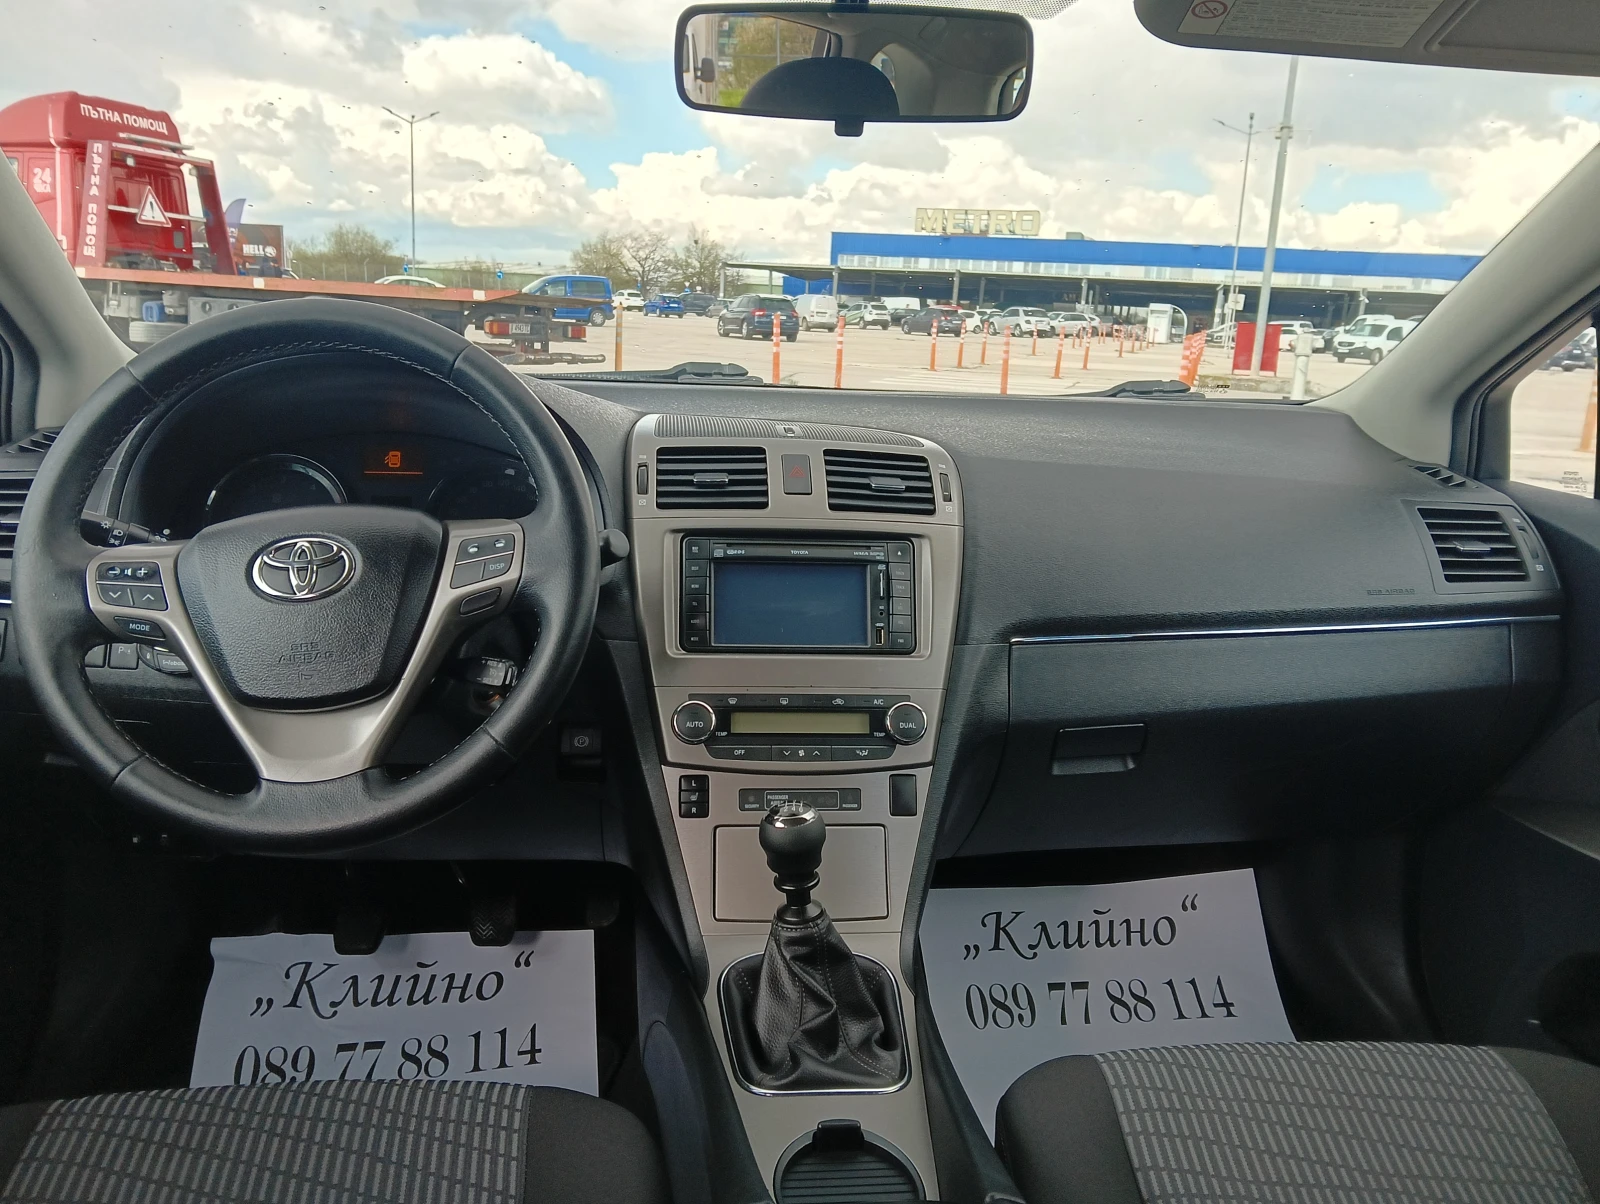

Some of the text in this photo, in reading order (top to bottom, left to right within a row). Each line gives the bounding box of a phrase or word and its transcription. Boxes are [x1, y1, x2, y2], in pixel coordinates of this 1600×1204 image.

[80, 103, 168, 136] ПЪТНА ПОМОЩ
[33, 167, 52, 184] 24
[83, 142, 103, 258] ПЪТНА ПОМОЩ
[915, 207, 1040, 236] METRO
[242, 244, 264, 255] HELL
[489, 563, 505, 571] DISP
[129, 623, 151, 632] MODE
[962, 893, 1198, 960] „Клийно“
[249, 950, 535, 1020] „Клийно“
[965, 975, 1239, 1030] 089 77 88 114
[233, 1022, 543, 1086] 089 77 88 114
